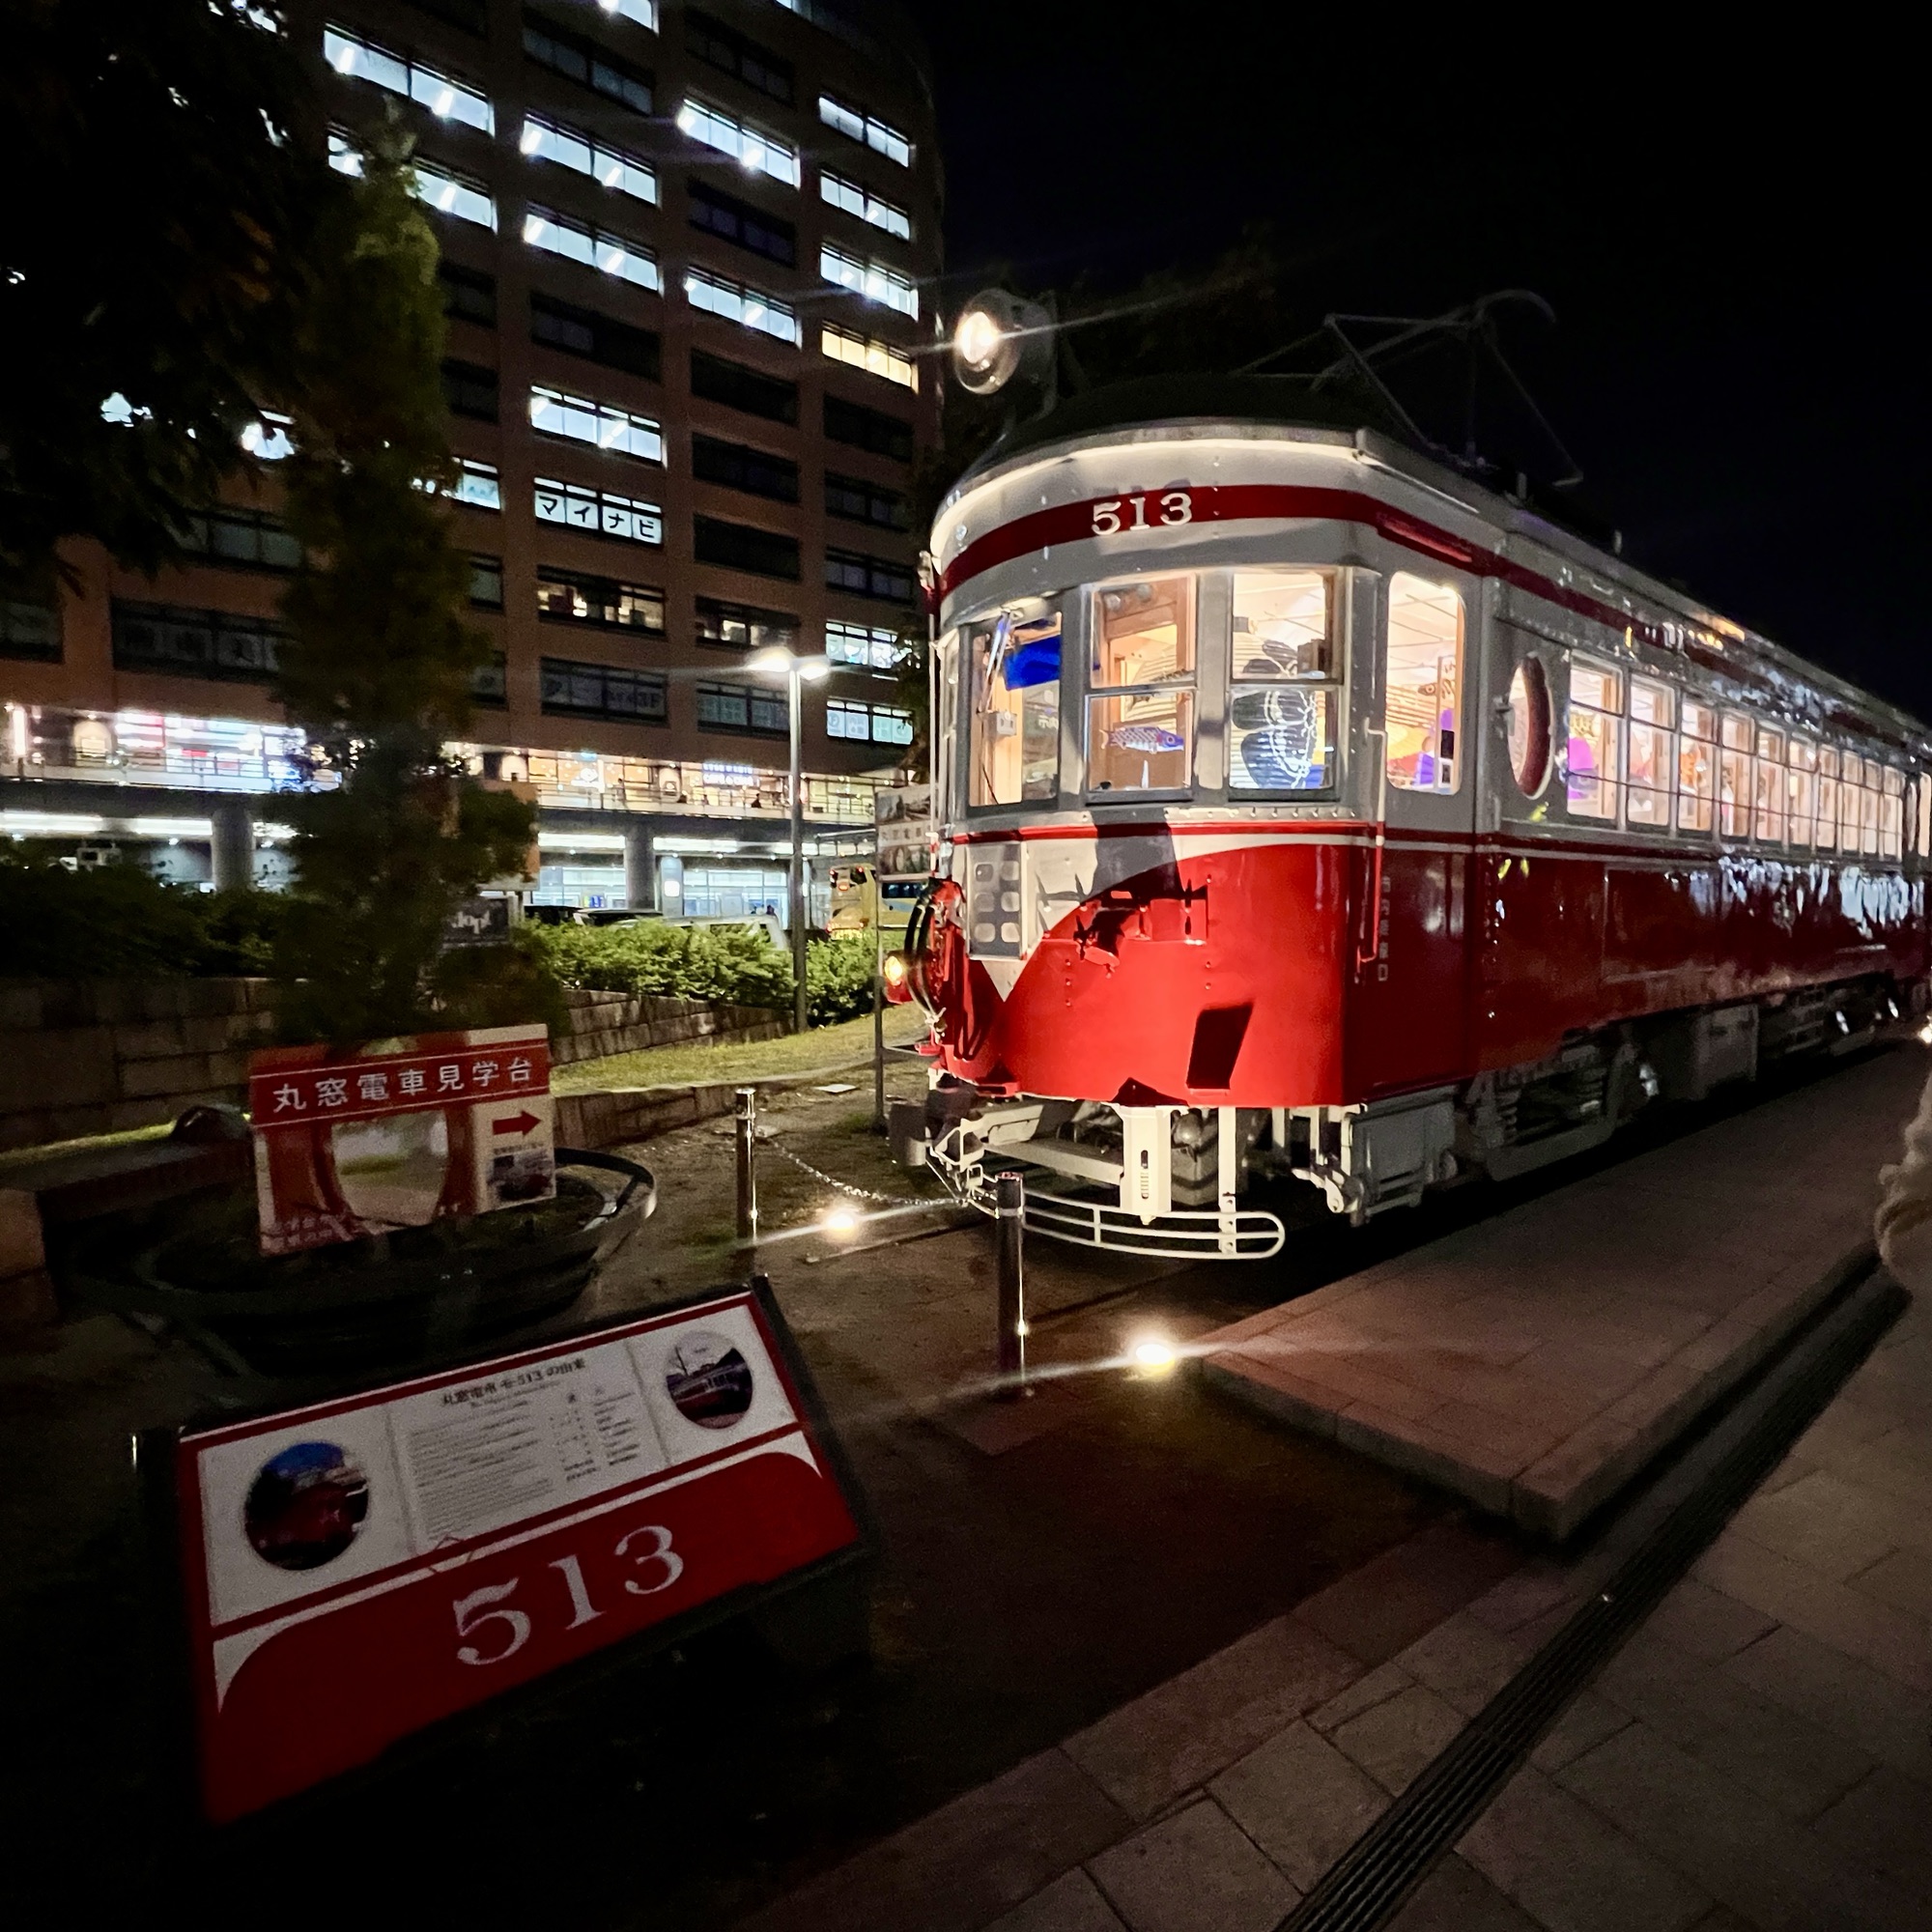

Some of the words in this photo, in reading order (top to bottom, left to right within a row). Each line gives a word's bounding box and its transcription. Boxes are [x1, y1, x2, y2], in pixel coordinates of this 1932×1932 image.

[538, 495, 655, 538] マイナビ
[1092, 492, 1193, 535] 513
[272, 1057, 532, 1113] 丸窓電車見学台
[452, 1525, 685, 1665] 513
